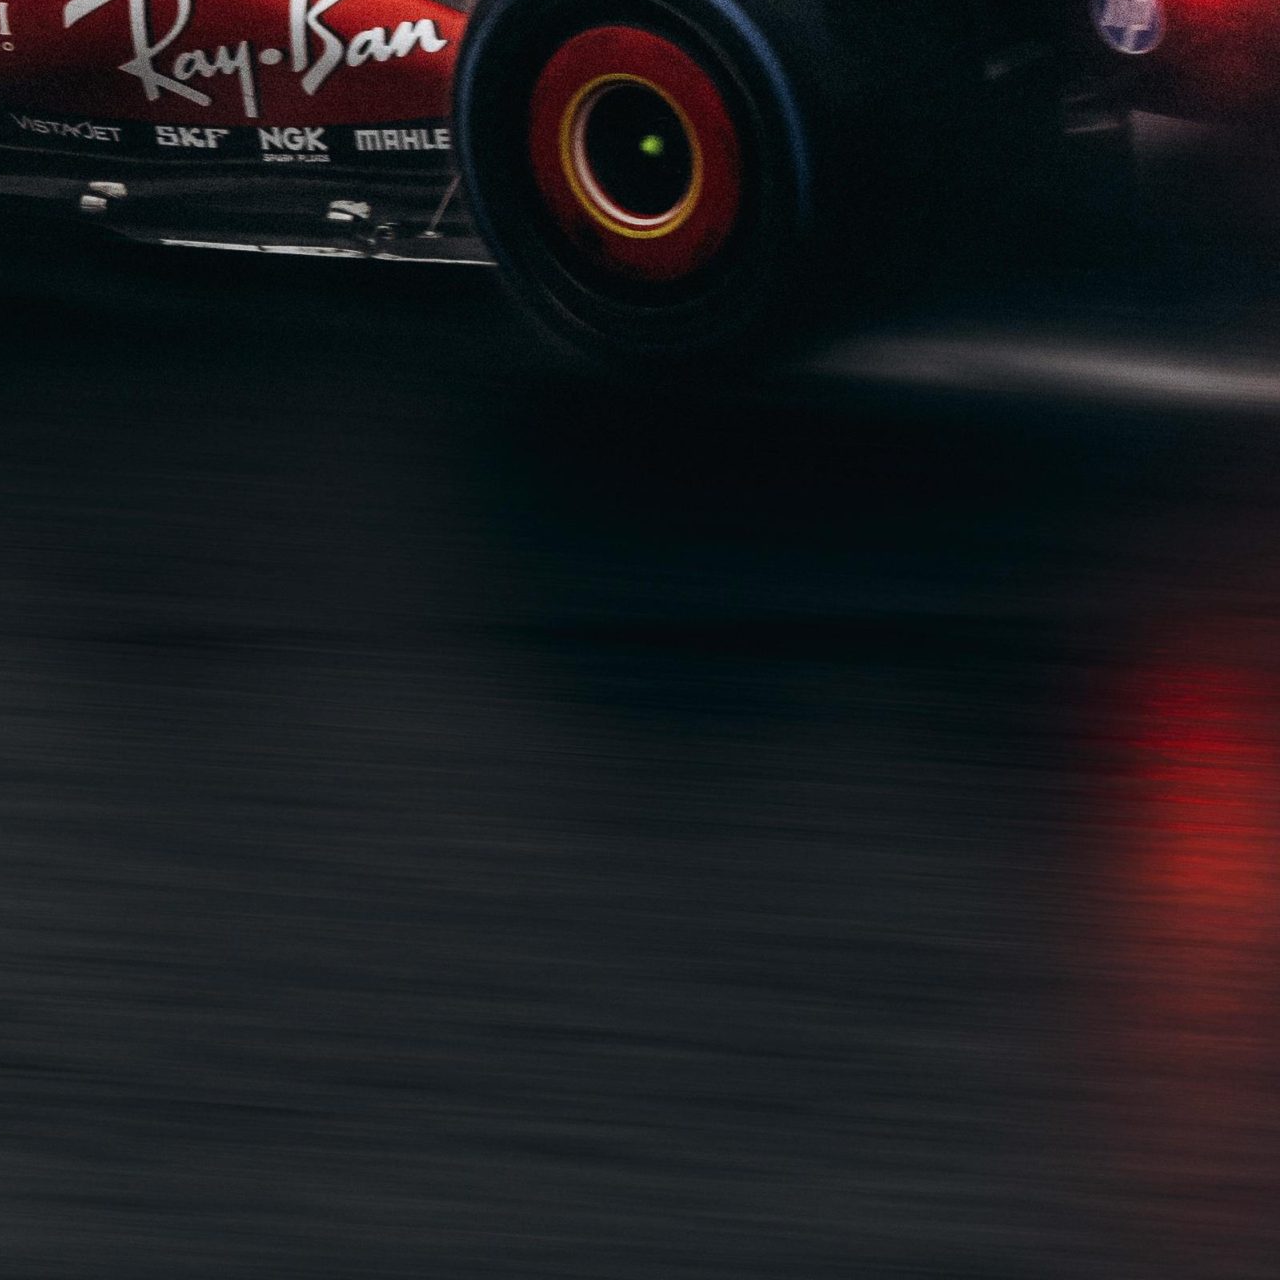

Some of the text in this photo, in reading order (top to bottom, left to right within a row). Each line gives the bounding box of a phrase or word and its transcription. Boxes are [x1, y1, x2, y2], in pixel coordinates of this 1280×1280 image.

[154, 125, 229, 149] SKF
[258, 127, 329, 151] NGK
[354, 128, 451, 151] MAHLE
